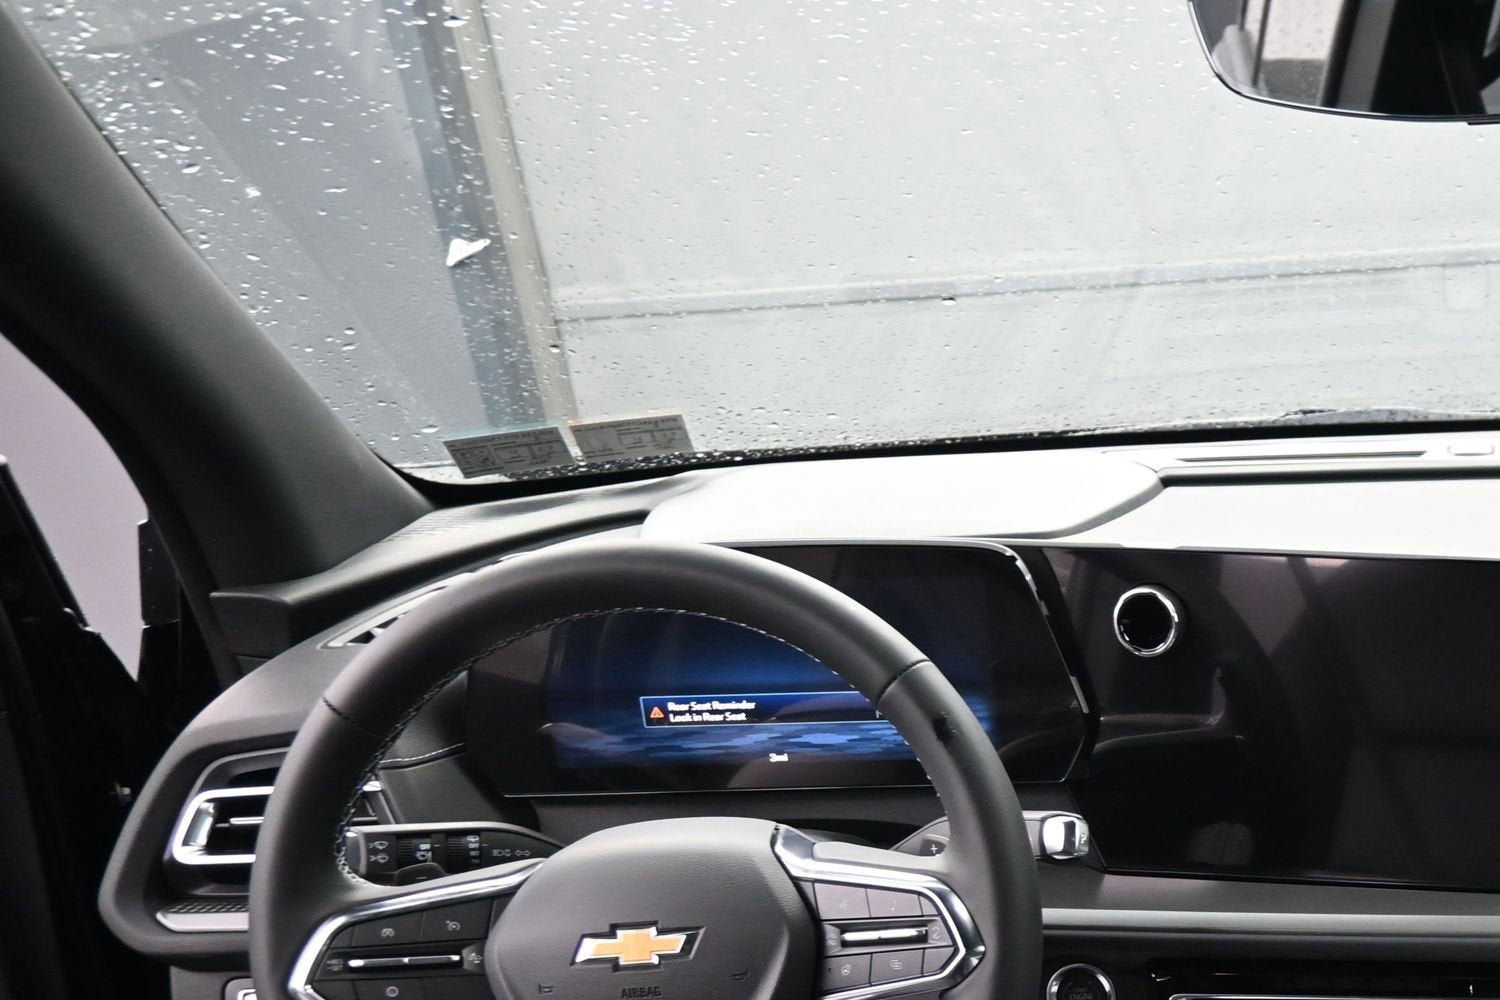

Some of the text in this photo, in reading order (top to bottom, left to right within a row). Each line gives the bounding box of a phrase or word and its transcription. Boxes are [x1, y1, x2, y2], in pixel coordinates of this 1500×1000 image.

[667, 700, 757, 712] Rear Seat Reminder
[669, 712, 747, 723] Look in Rear Seat
[621, 986, 662, 999] AIRBAG
